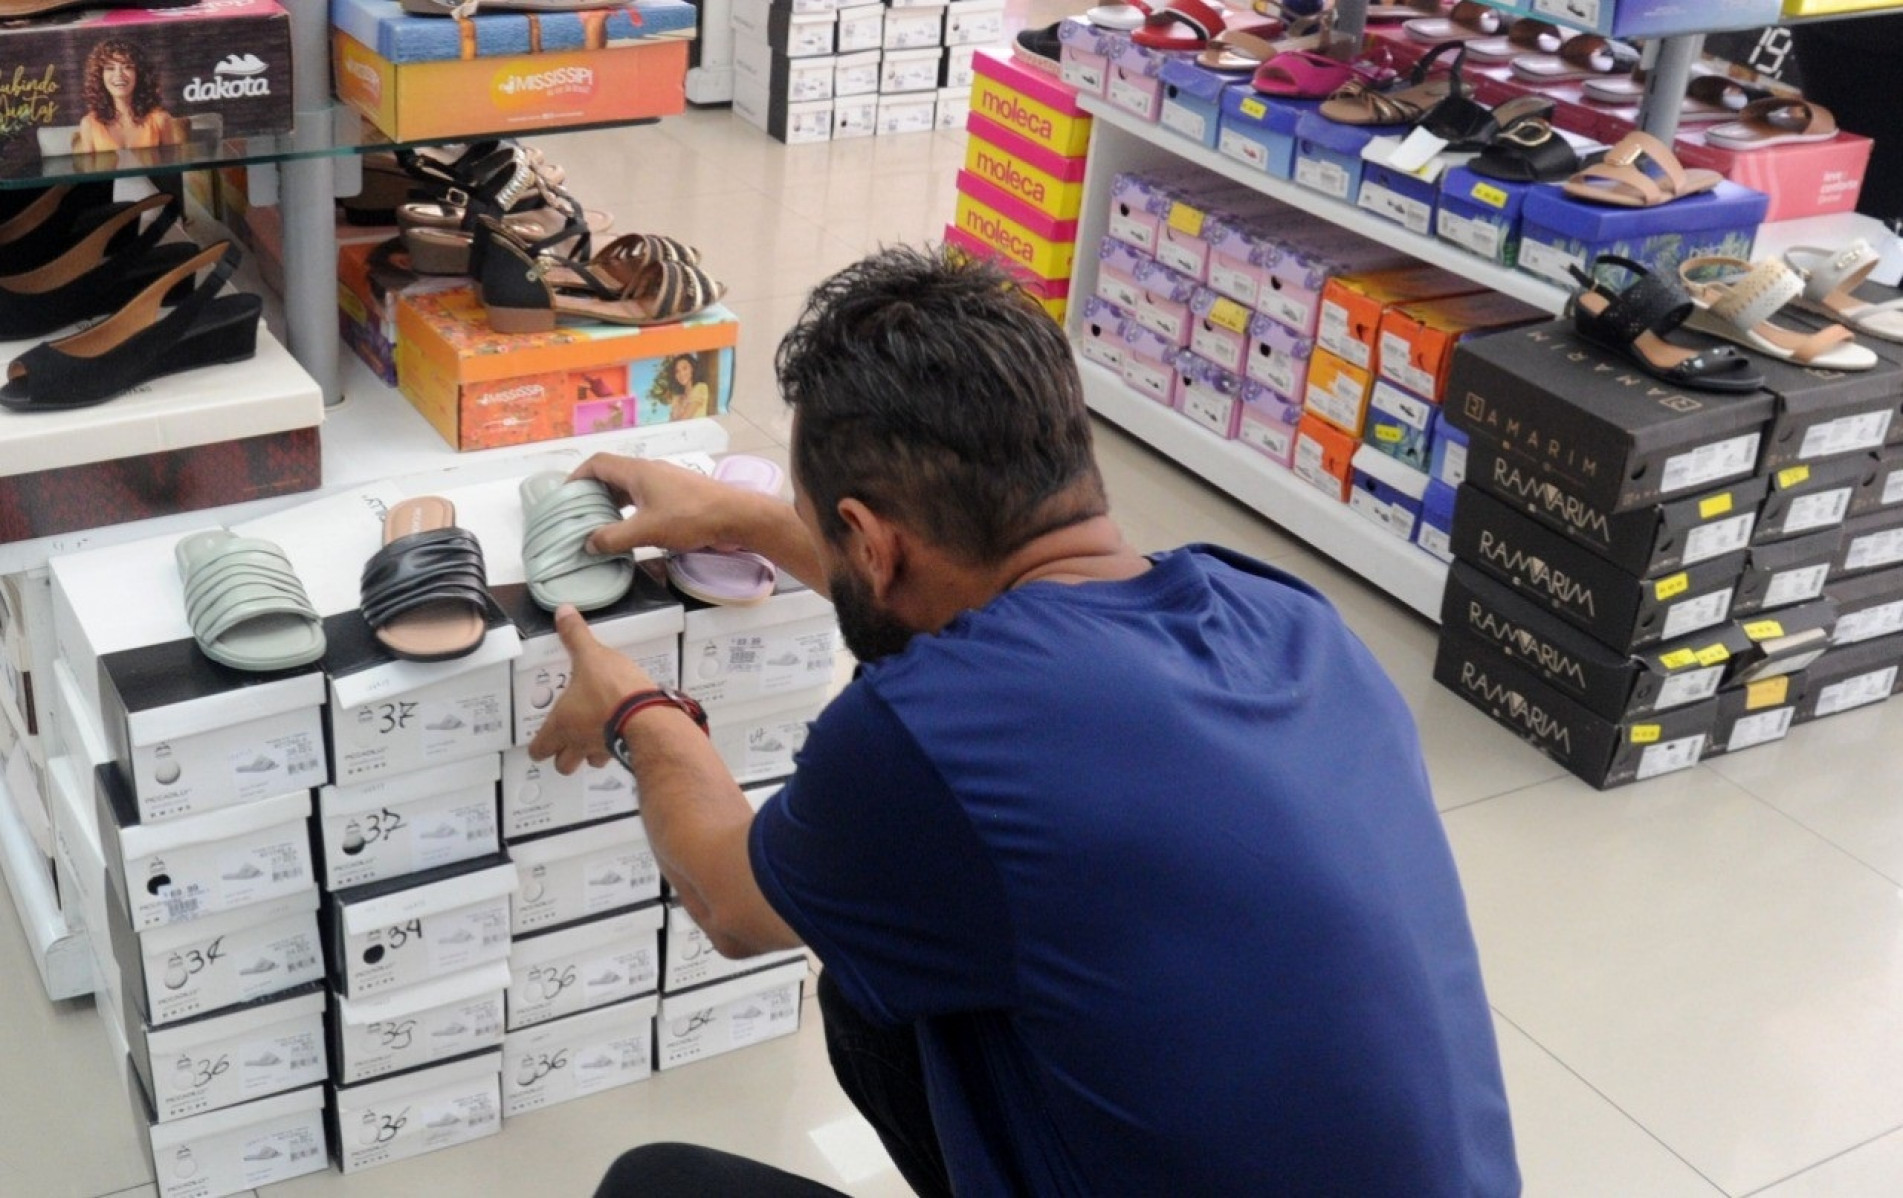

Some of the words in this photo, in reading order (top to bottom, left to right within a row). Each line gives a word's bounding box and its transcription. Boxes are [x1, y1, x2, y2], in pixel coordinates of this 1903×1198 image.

[183, 76, 270, 102] dakota
[982, 89, 1052, 140] moleca
[977, 150, 1045, 203] moleca
[967, 208, 1034, 262] moleca
[1494, 457, 1610, 543] RAMARIM
[1479, 530, 1595, 618] RAMARIM
[1469, 601, 1586, 689] RAMARIM
[379, 701, 419, 734] 37
[1461, 661, 1571, 755] RAMARIM
[388, 917, 422, 949] 34
[544, 965, 576, 1000] 36
[194, 1054, 230, 1087] 36
